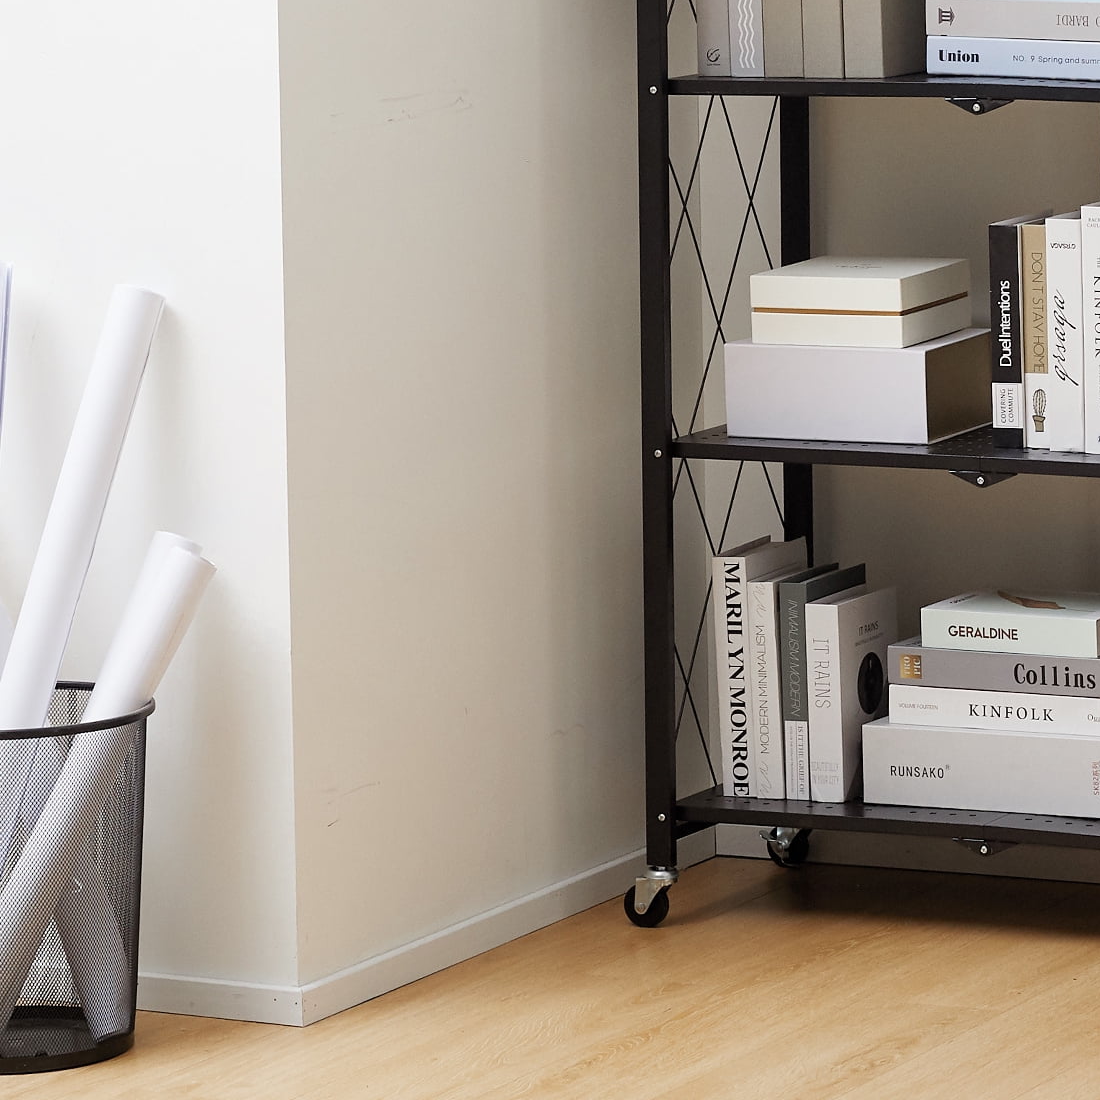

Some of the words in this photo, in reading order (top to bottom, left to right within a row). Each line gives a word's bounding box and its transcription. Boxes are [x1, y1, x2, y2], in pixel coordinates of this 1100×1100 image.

[1056, 13, 1089, 27] BARDI
[938, 49, 980, 63] Union
[1030, 55, 1035, 63] 9
[1038, 55, 1063, 66] Spring
[1065, 57, 1080, 65] and
[1000, 279, 1010, 334] Intentions
[1032, 297, 1044, 333] STAY
[1000, 334, 1012, 367] Duel
[1032, 335, 1045, 373] HOME
[812, 637, 830, 655] IT
[948, 625, 1019, 641] GERALDINE
[754, 625, 767, 697] MINIMALISM
[913, 657, 921, 676] PIC
[1013, 663, 1097, 689] Collins
[788, 661, 801, 717] MODERN
[814, 660, 831, 709] RAINS
[758, 700, 770, 754] MODERN
[968, 703, 1054, 722] KINFOLK
[729, 686, 750, 797] MONROE
